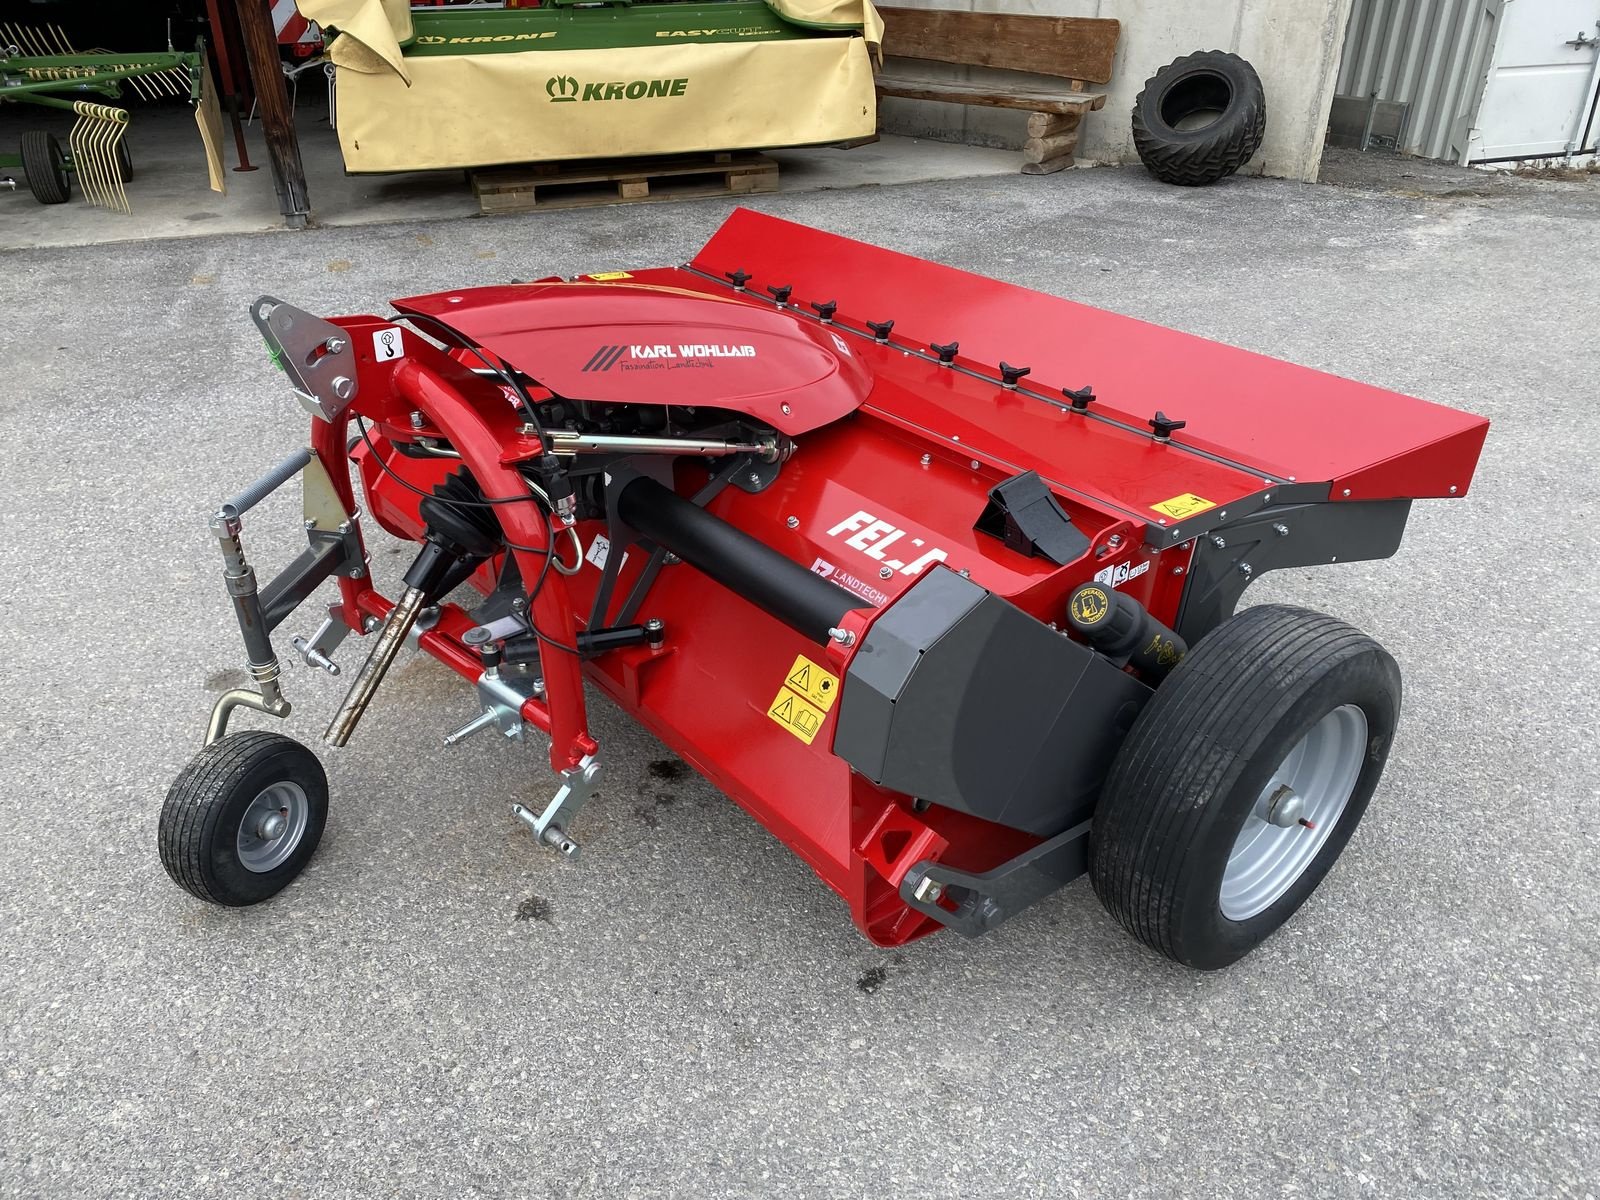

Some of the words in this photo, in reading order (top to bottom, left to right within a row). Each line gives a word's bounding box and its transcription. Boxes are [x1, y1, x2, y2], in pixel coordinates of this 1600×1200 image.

[449, 31, 557, 44] KRONE
[582, 78, 688, 101] KRONE
[630, 344, 677, 359] KARL
[678, 344, 756, 358] WOHLLAIB
